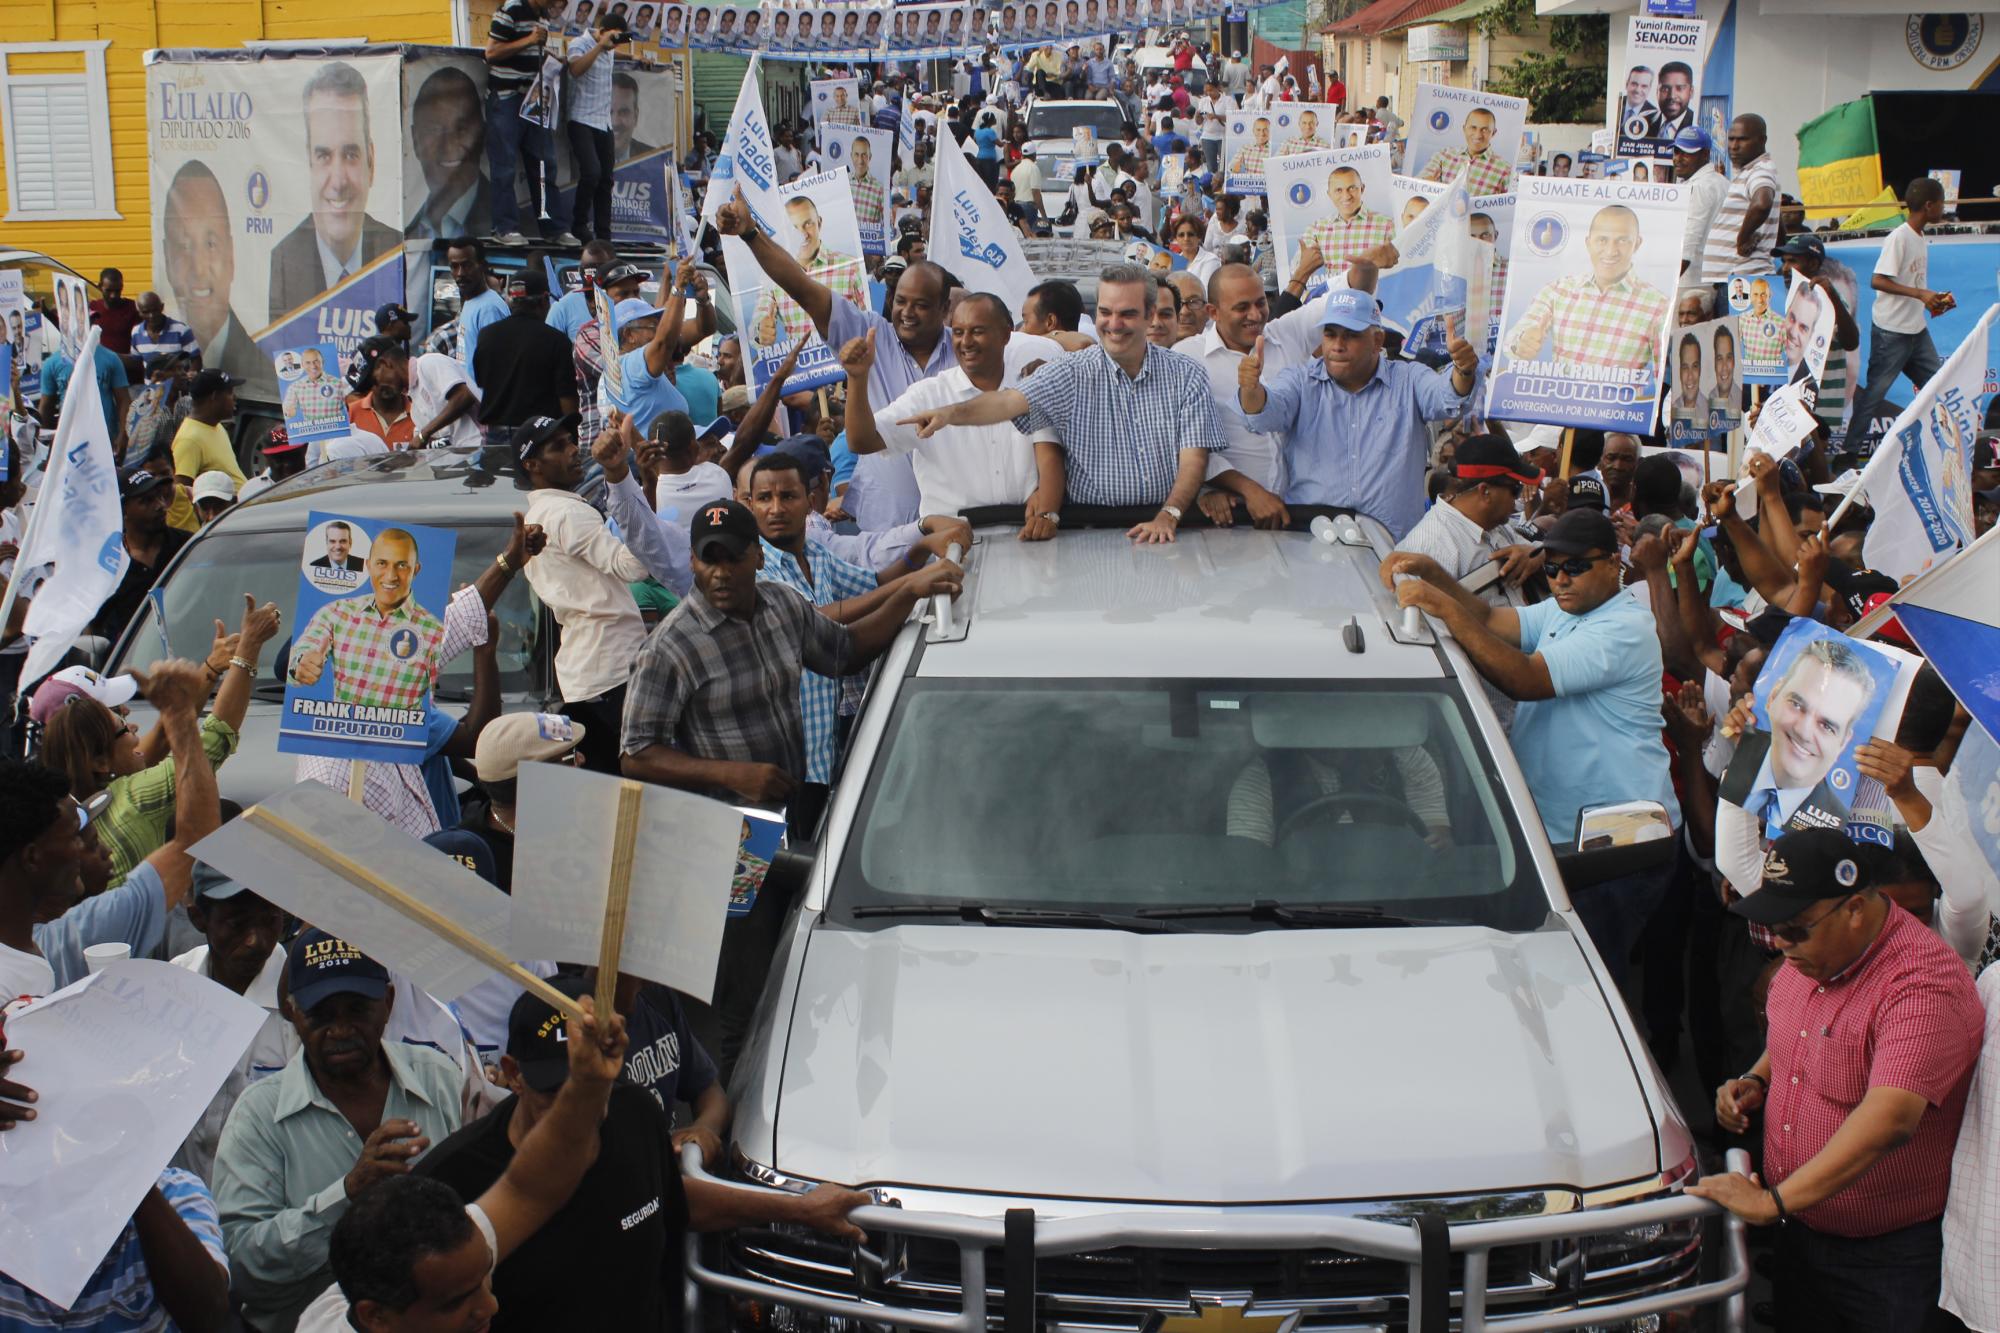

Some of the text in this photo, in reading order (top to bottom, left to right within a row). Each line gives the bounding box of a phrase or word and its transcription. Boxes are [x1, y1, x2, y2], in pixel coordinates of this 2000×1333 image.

[1635, 20, 1663, 32] Yuniol
[1635, 31, 1697, 46] SENADOR
[160, 82, 253, 120] EULALIO
[1432, 89, 1520, 110] SUMATE AL CAMBIO
[160, 121, 251, 139] DIPUTADO 2016
[1282, 149, 1380, 171] SUMATE AL CAMBIO
[612, 181, 652, 200] UIS
[792, 170, 838, 192] CAMBIO
[1532, 182, 1679, 202] SUMATE AL CAMBIO
[611, 198, 651, 211] BINADER
[954, 190, 981, 224] Luis
[1474, 196, 1516, 210] CAMBIO
[246, 217, 273, 235] PRM
[1332, 294, 1356, 305] LUIS
[317, 306, 377, 337] LUIS
[1507, 359, 1567, 379] FRANK
[1514, 376, 1637, 406] DIPUTADO
[1502, 399, 1644, 422] CONVERGENCIA POR UN MEJOR PAIS
[1581, 480, 1600, 491] POLY
[706, 507, 729, 526] T
[1917, 495, 1948, 545] 2016-2020
[314, 566, 357, 581] LUIS
[293, 698, 426, 726] FRANK RAMIREZ
[312, 717, 405, 740] DIPUTADO
[1806, 804, 1841, 827] LUIS
[306, 951, 362, 967] ABINADER
[319, 958, 350, 969] 2016
